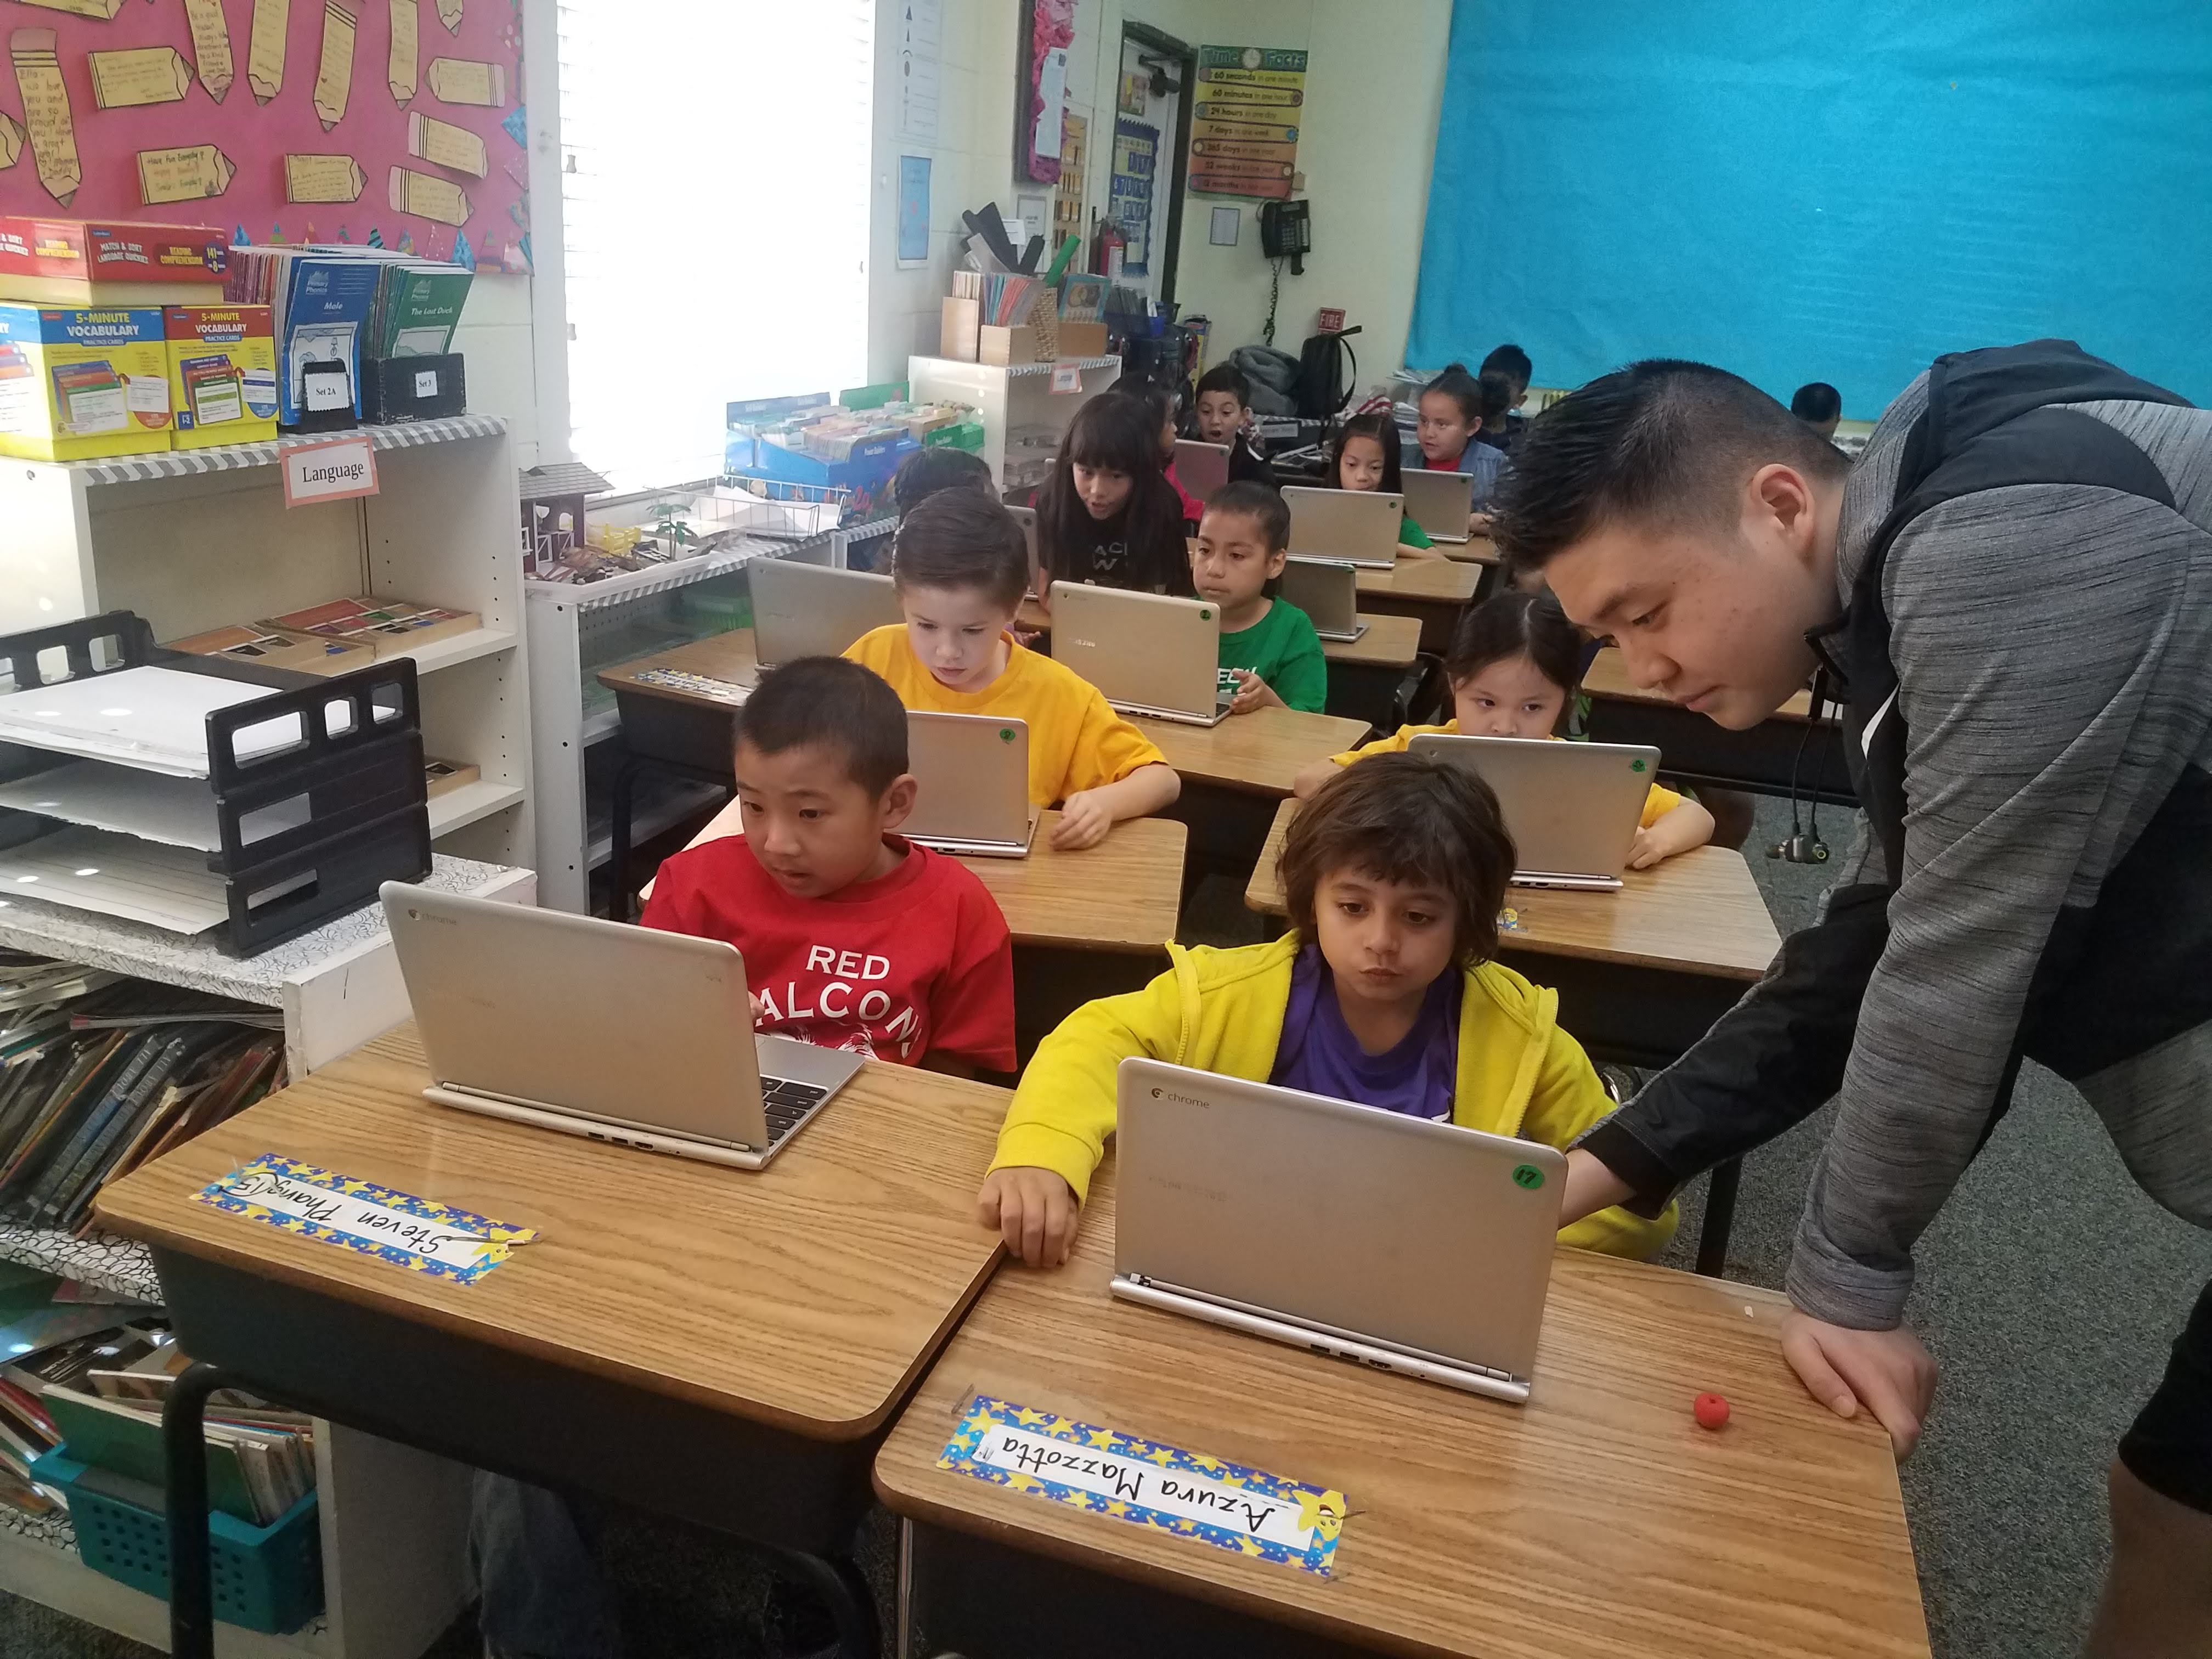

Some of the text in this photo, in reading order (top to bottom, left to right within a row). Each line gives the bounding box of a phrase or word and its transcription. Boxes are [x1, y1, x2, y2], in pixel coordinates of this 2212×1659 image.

[1265, 50, 1304, 66] Facts
[47, 79, 61, 91] love
[26, 93, 63, 106] you and
[1222, 108, 1244, 116] hours
[1215, 127, 1233, 136] days
[1222, 145, 1240, 154] days
[212, 261, 218, 273] 8
[76, 313, 130, 323] 5-MINUTE
[201, 313, 240, 321] 5-MINUTE
[1321, 313, 1340, 328] FIRE
[66, 325, 139, 337] VOCABULARY
[195, 324, 247, 334] VOCABULARY
[316, 388, 326, 396] Set
[303, 464, 364, 483] Language
[422, 913, 457, 926] chrome
[806, 945, 891, 980] RED
[1168, 1093, 1210, 1109] chrome
[1516, 1169, 1537, 1185] 17
[267, 1179, 342, 1222] Phang
[357, 1211, 451, 1255] Steven
[1002, 1436, 1276, 1533] Azura Mazzotta
